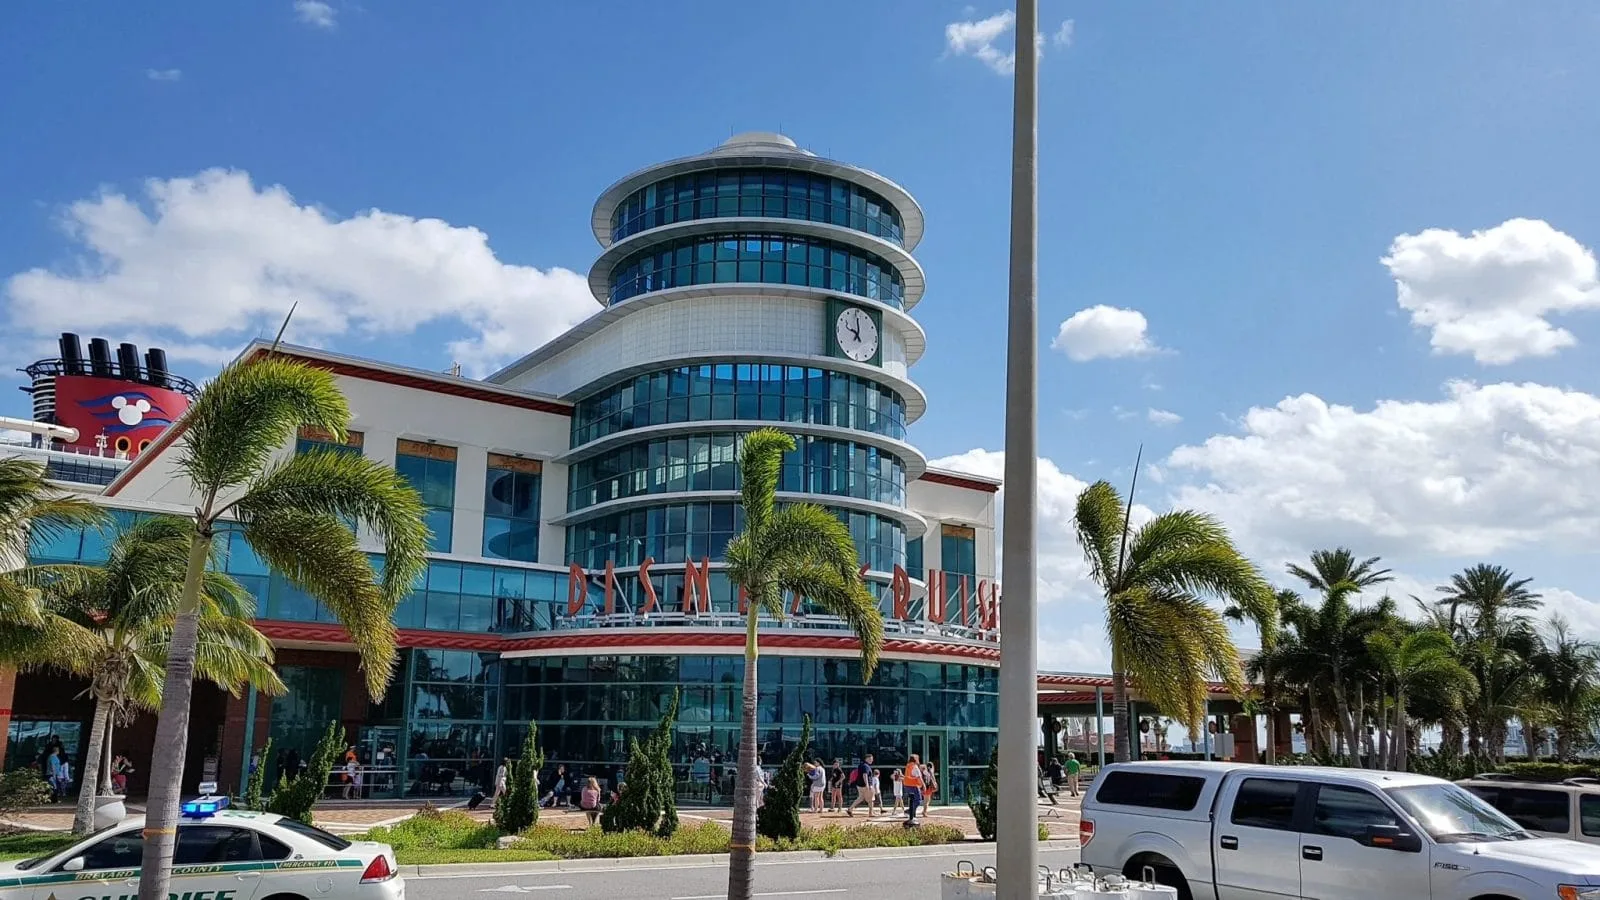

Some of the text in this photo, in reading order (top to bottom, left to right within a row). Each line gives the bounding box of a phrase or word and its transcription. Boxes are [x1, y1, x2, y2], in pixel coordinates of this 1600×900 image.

[567, 555, 1000, 630] DISN RUIS
[75, 864, 224, 881] BREVARD COUNTY
